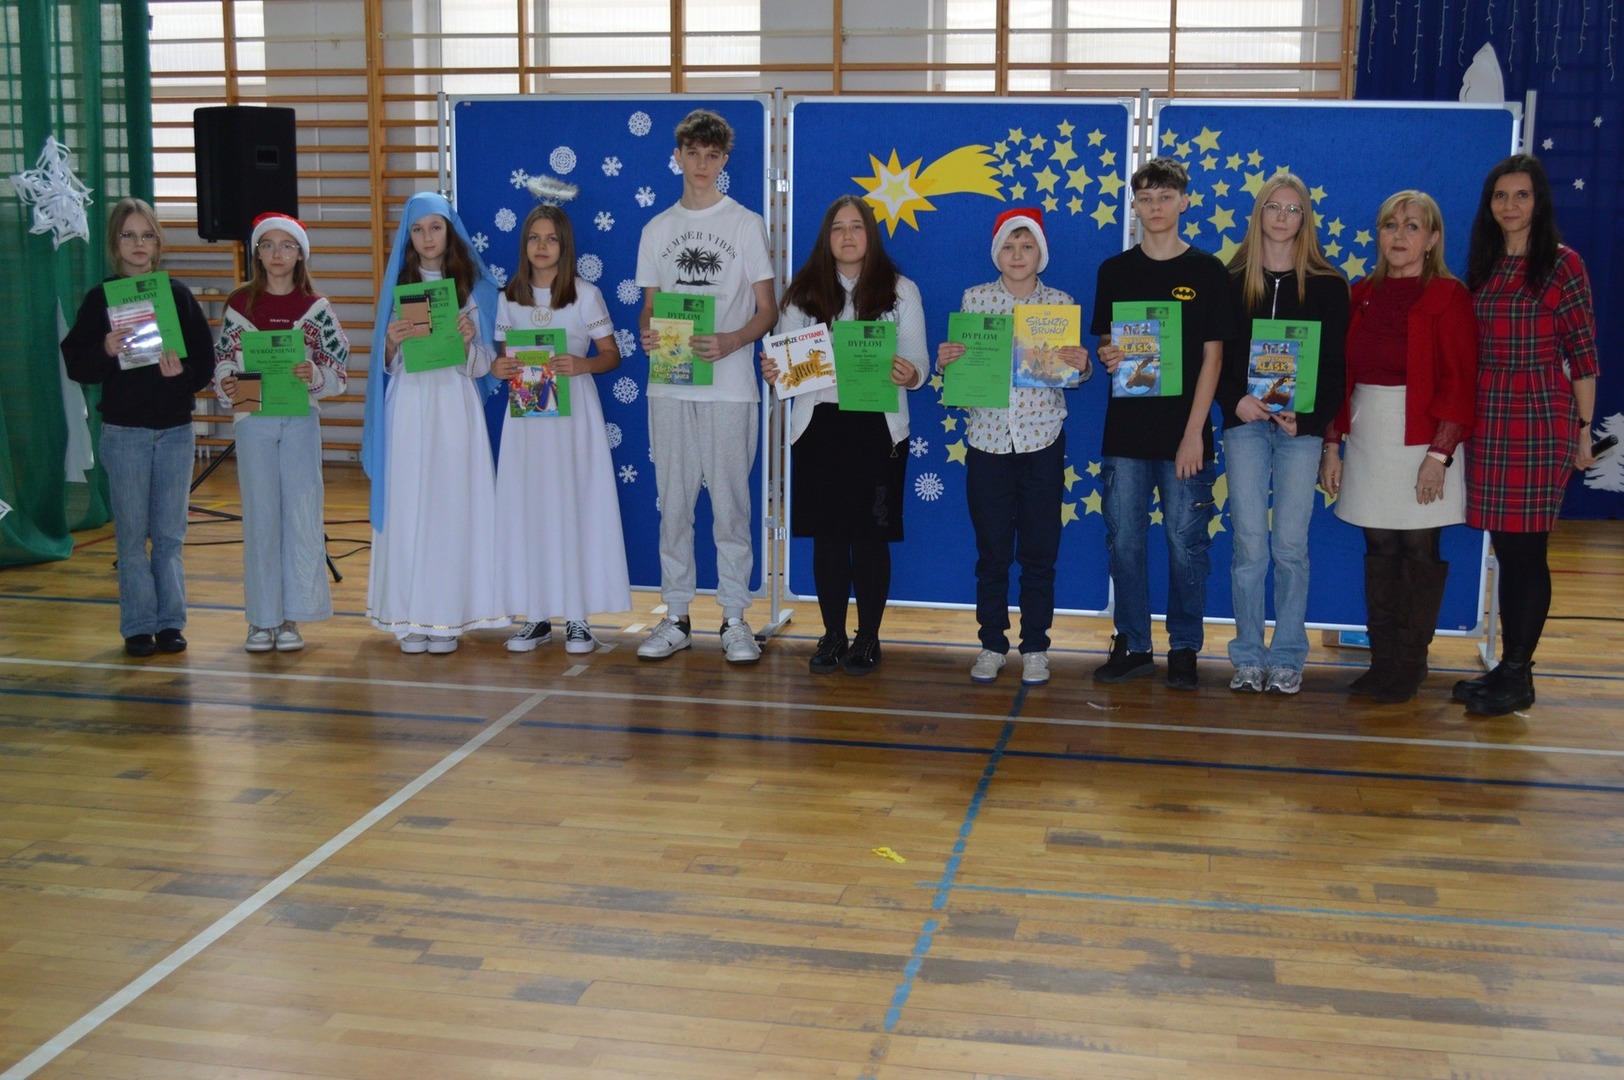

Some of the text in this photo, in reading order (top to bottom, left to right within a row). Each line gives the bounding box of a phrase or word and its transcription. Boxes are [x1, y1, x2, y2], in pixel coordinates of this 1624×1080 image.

[661, 230, 738, 260] SUMMER VIBES
[122, 291, 158, 304] DYPLOM
[667, 312, 700, 321] DYPLOM
[798, 329, 825, 342] CZYTANKI
[1030, 325, 1066, 336] BRUNO!
[962, 332, 998, 341] DYPLOM
[1119, 342, 1157, 352] ALASKA
[1255, 362, 1294, 372] ALASKA
